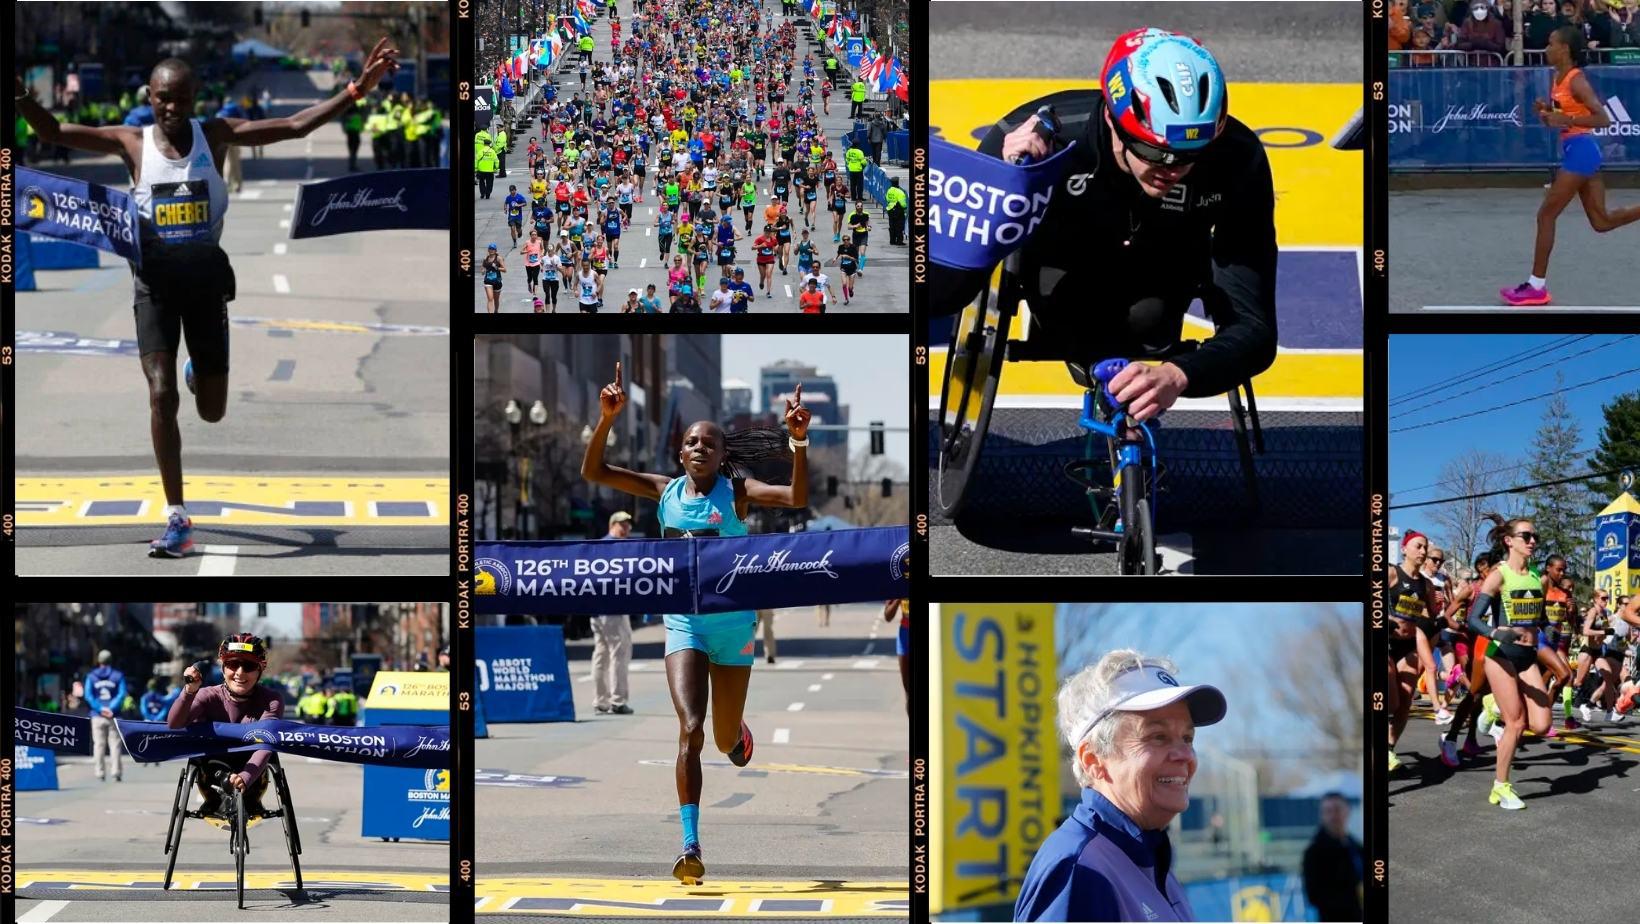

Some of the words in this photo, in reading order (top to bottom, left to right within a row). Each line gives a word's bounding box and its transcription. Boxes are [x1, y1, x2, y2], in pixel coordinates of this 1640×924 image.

[1176, 62, 1194, 97] CLIF
[1431, 104, 1468, 134] John
[1467, 103, 1524, 127] Hancock
[929, 168, 1053, 214] BOSTON
[53, 192, 87, 210] 126TH
[155, 201, 209, 226] CHEBET
[515, 560, 569, 576] 126TH
[574, 557, 674, 575] BOSTON
[716, 553, 763, 594] John
[761, 549, 839, 579] Hancock
[516, 577, 674, 596] MARATHON
[491, 658, 532, 667] ABBOTT
[492, 666, 530, 675] WORLD
[494, 673, 555, 683] MARATHON
[495, 682, 539, 691] MAJORS
[278, 731, 315, 742] 126TH
[318, 733, 386, 747] BOSTON
[403, 736, 438, 758] John
[953, 612, 1008, 895] START
